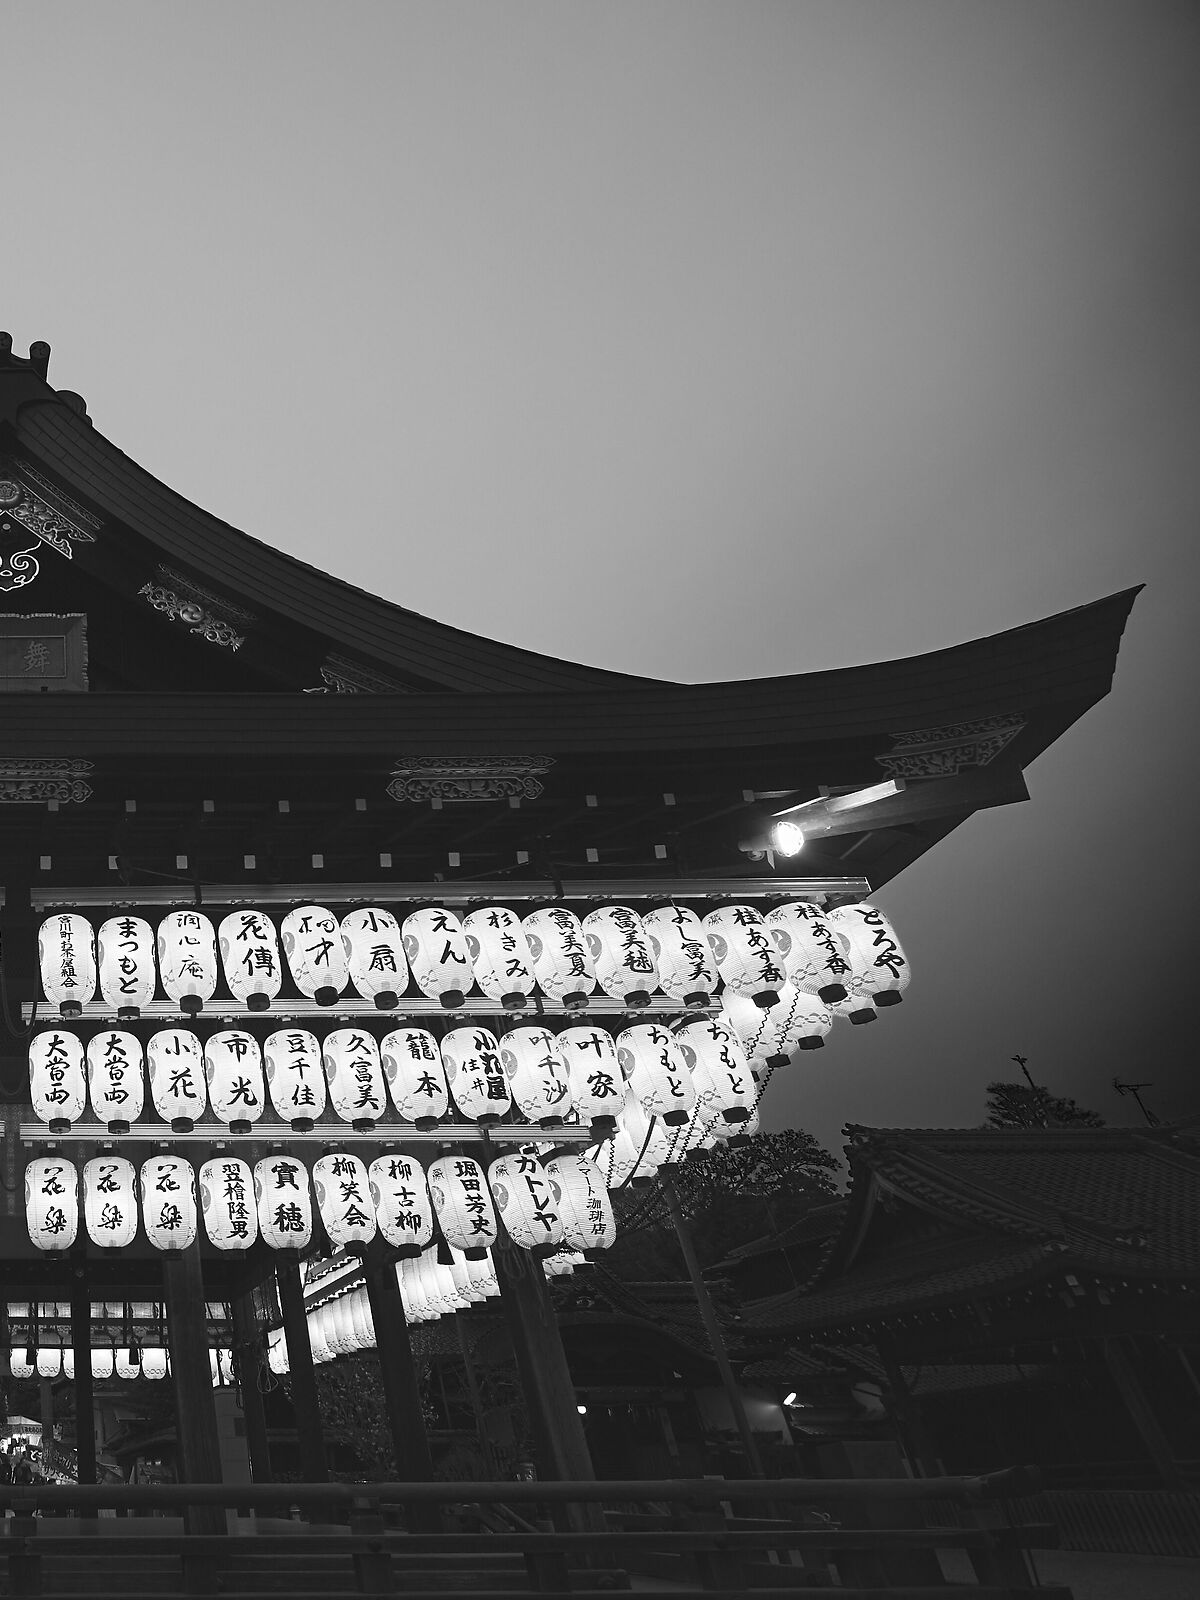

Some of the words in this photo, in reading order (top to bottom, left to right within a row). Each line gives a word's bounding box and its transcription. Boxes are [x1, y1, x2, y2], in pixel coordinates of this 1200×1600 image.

[116, 918, 139, 994] まつもと
[361, 911, 398, 973] 小扇
[430, 911, 467, 965] えん
[165, 1035, 198, 1098] 小花
[221, 1034, 258, 1106] 市光
[286, 1033, 316, 1107] 豆千佳
[345, 1033, 379, 1111] 久富美
[647, 1025, 686, 1098] ちもと
[706, 1022, 746, 1095] ちもと
[453, 1160, 494, 1237] 堀田芳史
[513, 1155, 559, 1232] カトレヤ
[575, 1151, 607, 1236] スマート珈琲店
